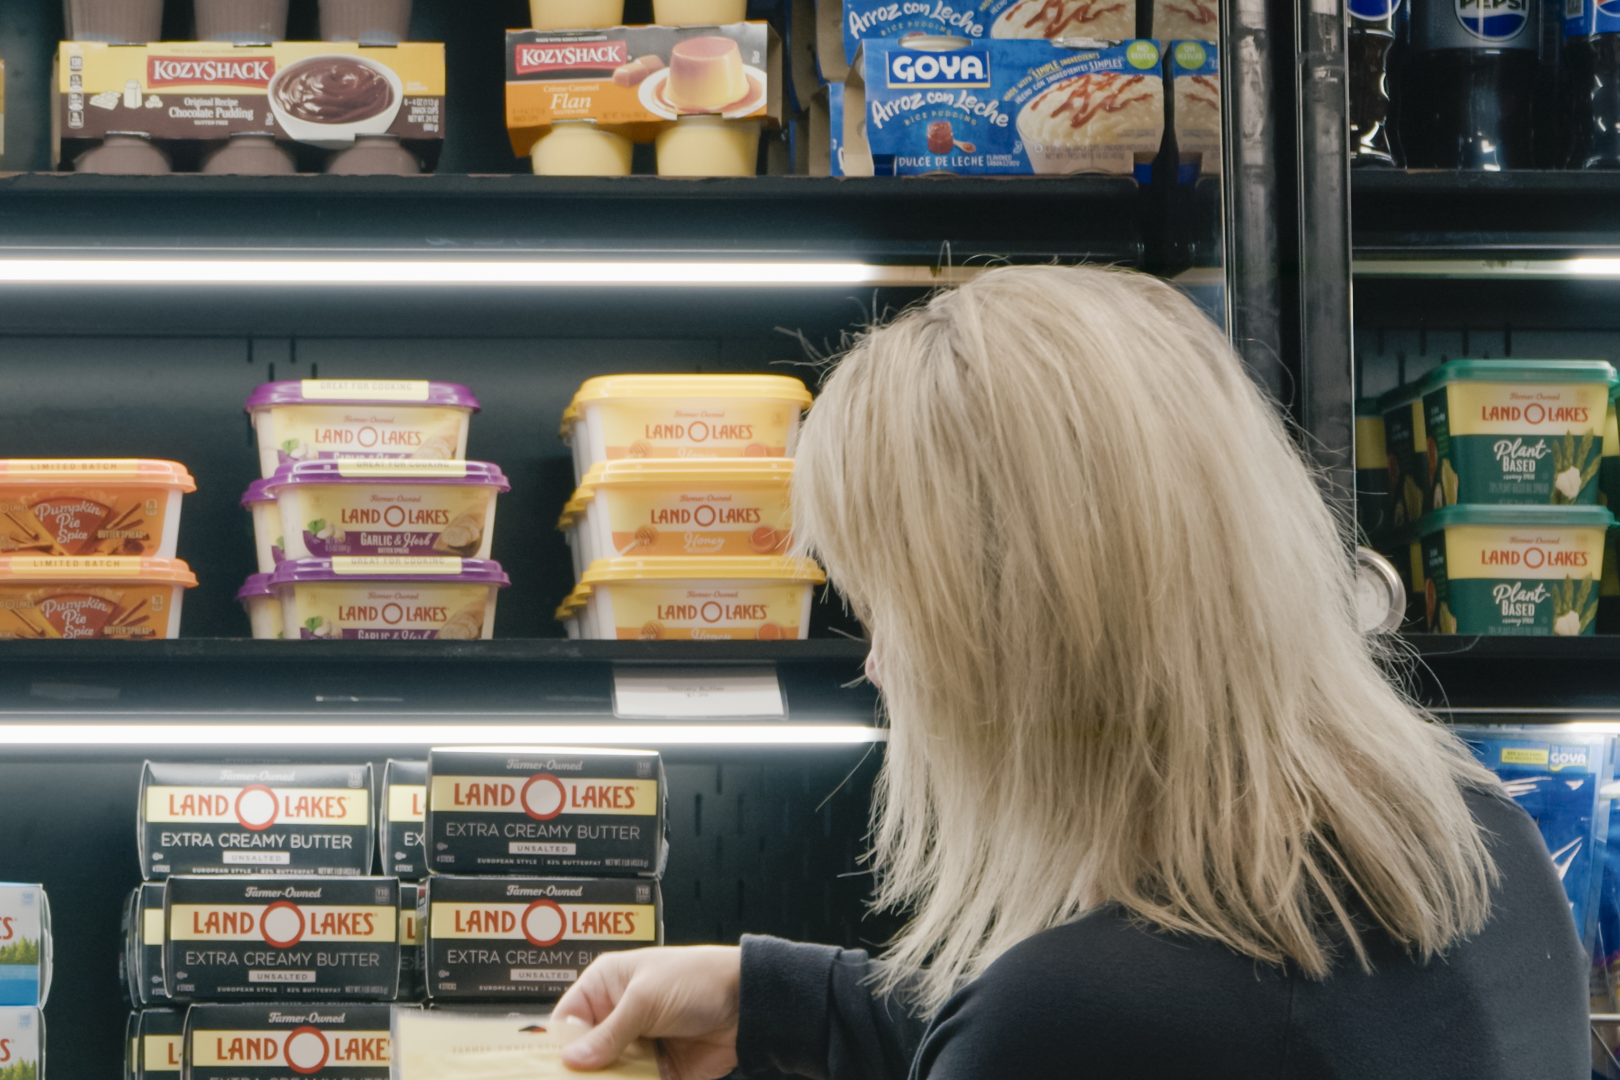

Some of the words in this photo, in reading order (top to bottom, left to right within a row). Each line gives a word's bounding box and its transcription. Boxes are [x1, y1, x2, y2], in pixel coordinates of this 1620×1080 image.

[522, 44, 621, 67] KOZYSHACK
[152, 61, 269, 80] KOZYSHACK
[892, 55, 984, 83] GOYA
[184, 97, 213, 107] Original
[215, 98, 239, 107] Recipe
[550, 93, 592, 110] Flan
[871, 92, 926, 130] Arroz
[926, 88, 954, 106] con
[954, 90, 1010, 128] Leche
[169, 107, 214, 119] Chocolate
[215, 108, 254, 120] Pudding
[904, 111, 928, 126] RICE
[931, 110, 978, 126] PUDDING
[898, 156, 931, 167] DULCE
[935, 156, 948, 167] DE
[951, 155, 984, 167] LECHE
[1482, 406, 1521, 422] LAND
[1548, 407, 1588, 423] LAKES
[1503, 457, 1535, 473] BASED
[35, 500, 101, 521] Pumpkin
[341, 508, 381, 525] LAND
[408, 509, 450, 525] LAKES
[651, 508, 691, 525] LAND
[719, 508, 761, 524] LAKES
[57, 513, 80, 531] Pie
[57, 529, 88, 544] Spice
[360, 532, 393, 547] GARLIC
[393, 534, 403, 546] &
[402, 532, 433, 548] Herb
[684, 532, 725, 550] Honey
[33, 559, 79, 567] LIMITED
[84, 560, 120, 568] BATCH
[507, 759, 583, 771] Farmer-Owned
[1550, 752, 1586, 765] GOYA
[454, 783, 516, 807] LAND
[571, 785, 635, 809] LAKES
[446, 823, 499, 837] EXTRA
[504, 824, 573, 838] CREAMY
[577, 825, 640, 839] BUTTER
[517, 845, 568, 853] UNSALTED
